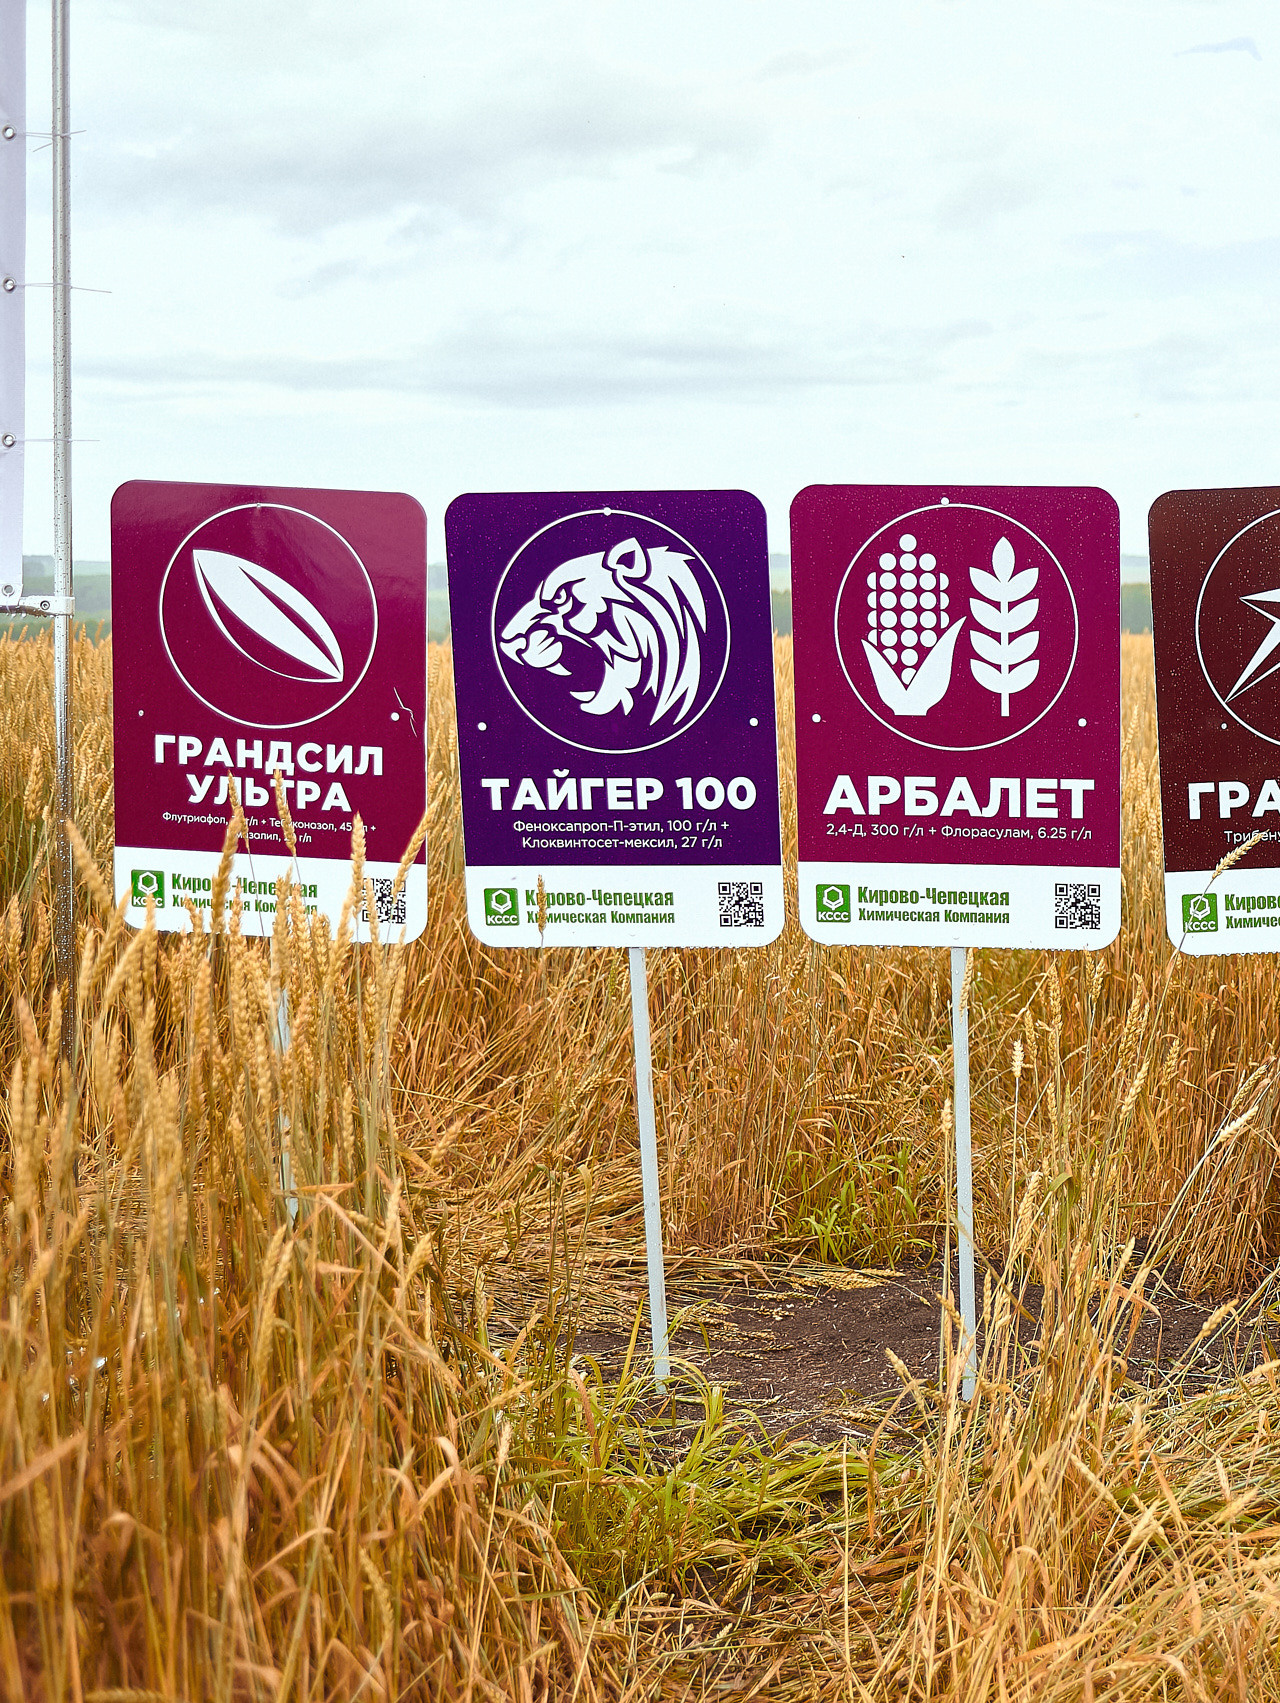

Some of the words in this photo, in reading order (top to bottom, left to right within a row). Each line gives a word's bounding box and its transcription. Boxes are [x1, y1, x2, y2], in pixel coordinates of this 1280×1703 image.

[154, 734, 383, 776] ГРАНДСИЛ
[186, 774, 352, 812] УЛЬТРА
[481, 768, 664, 811] ТАЙГЕР
[675, 776, 757, 810] 100
[822, 774, 1095, 819] АРБАЛЕТ
[162, 811, 229, 826] Флутриафол,
[513, 820, 664, 834] Феноксапроп-П-этил,
[667, 820, 692, 832] 100
[696, 820, 717, 832] г/л
[299, 833, 312, 843] г/л
[826, 823, 867, 837] 2,4-Д,
[871, 824, 899, 836] 300
[903, 824, 924, 837] г/л
[941, 825, 1034, 840] Флорасулам,
[1038, 827, 1067, 839] 6.25
[1071, 827, 1092, 841] г/л
[522, 837, 678, 850] Клоквинтосет-мексил,
[681, 837, 697, 848] 27
[701, 836, 723, 849] г/л
[525, 889, 674, 908] Крово-Чепецкая
[858, 886, 1010, 907] Кирово-Чепецкая
[611, 911, 675, 924] Компания
[859, 908, 940, 922] Химическая
[944, 909, 1010, 923] Компания
